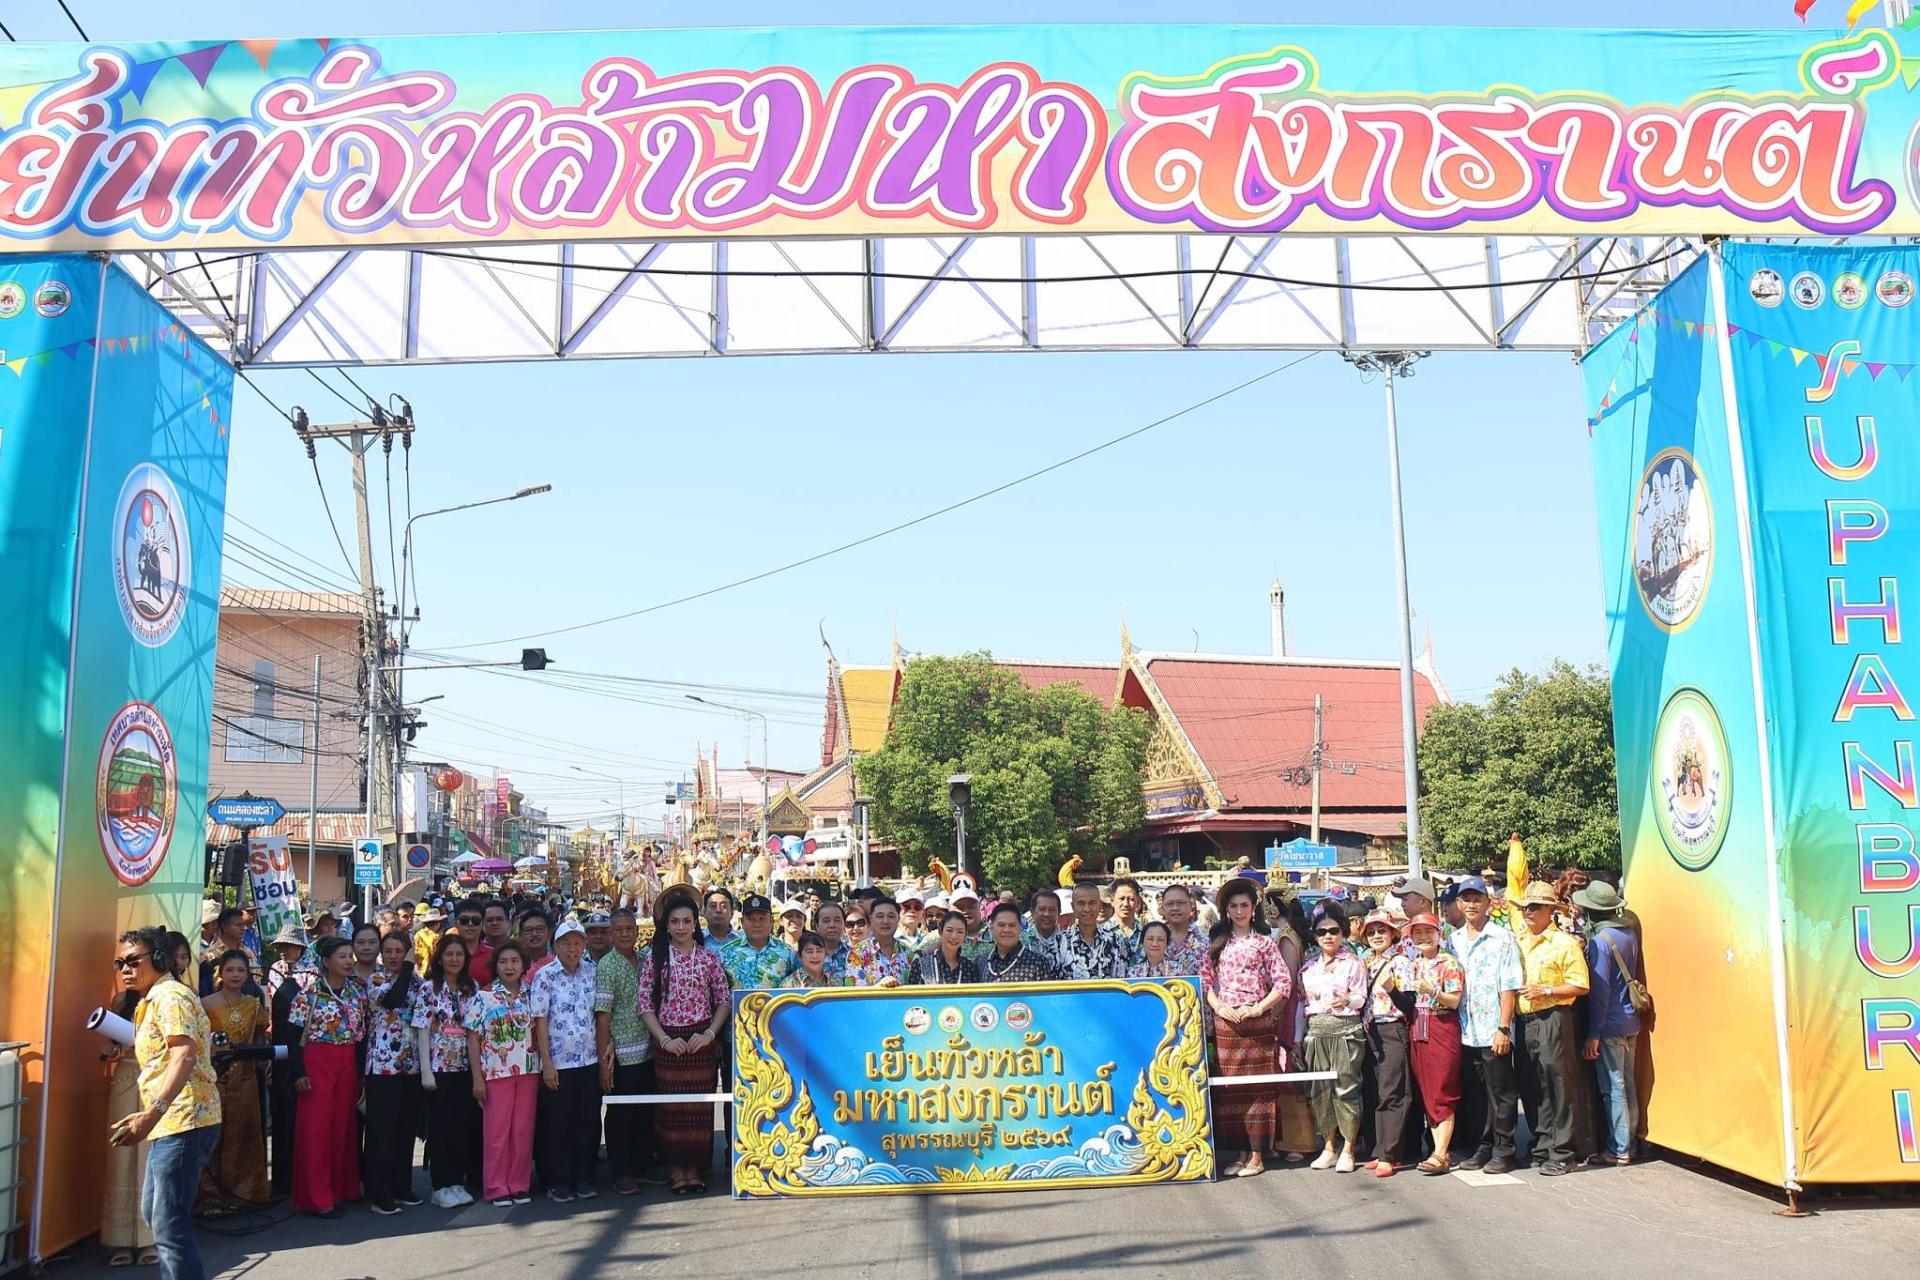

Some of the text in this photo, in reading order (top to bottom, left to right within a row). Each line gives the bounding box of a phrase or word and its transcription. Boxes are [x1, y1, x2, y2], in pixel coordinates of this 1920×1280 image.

[250, 843, 291, 875] รับ
[254, 877, 297, 901] ซ่อม
[864, 1030, 1064, 1081] เย็นทั่วหล้า
[833, 1060, 1117, 1125] มหาสงกรานต์
[881, 1122, 997, 1160] สุพรรณบุรี
